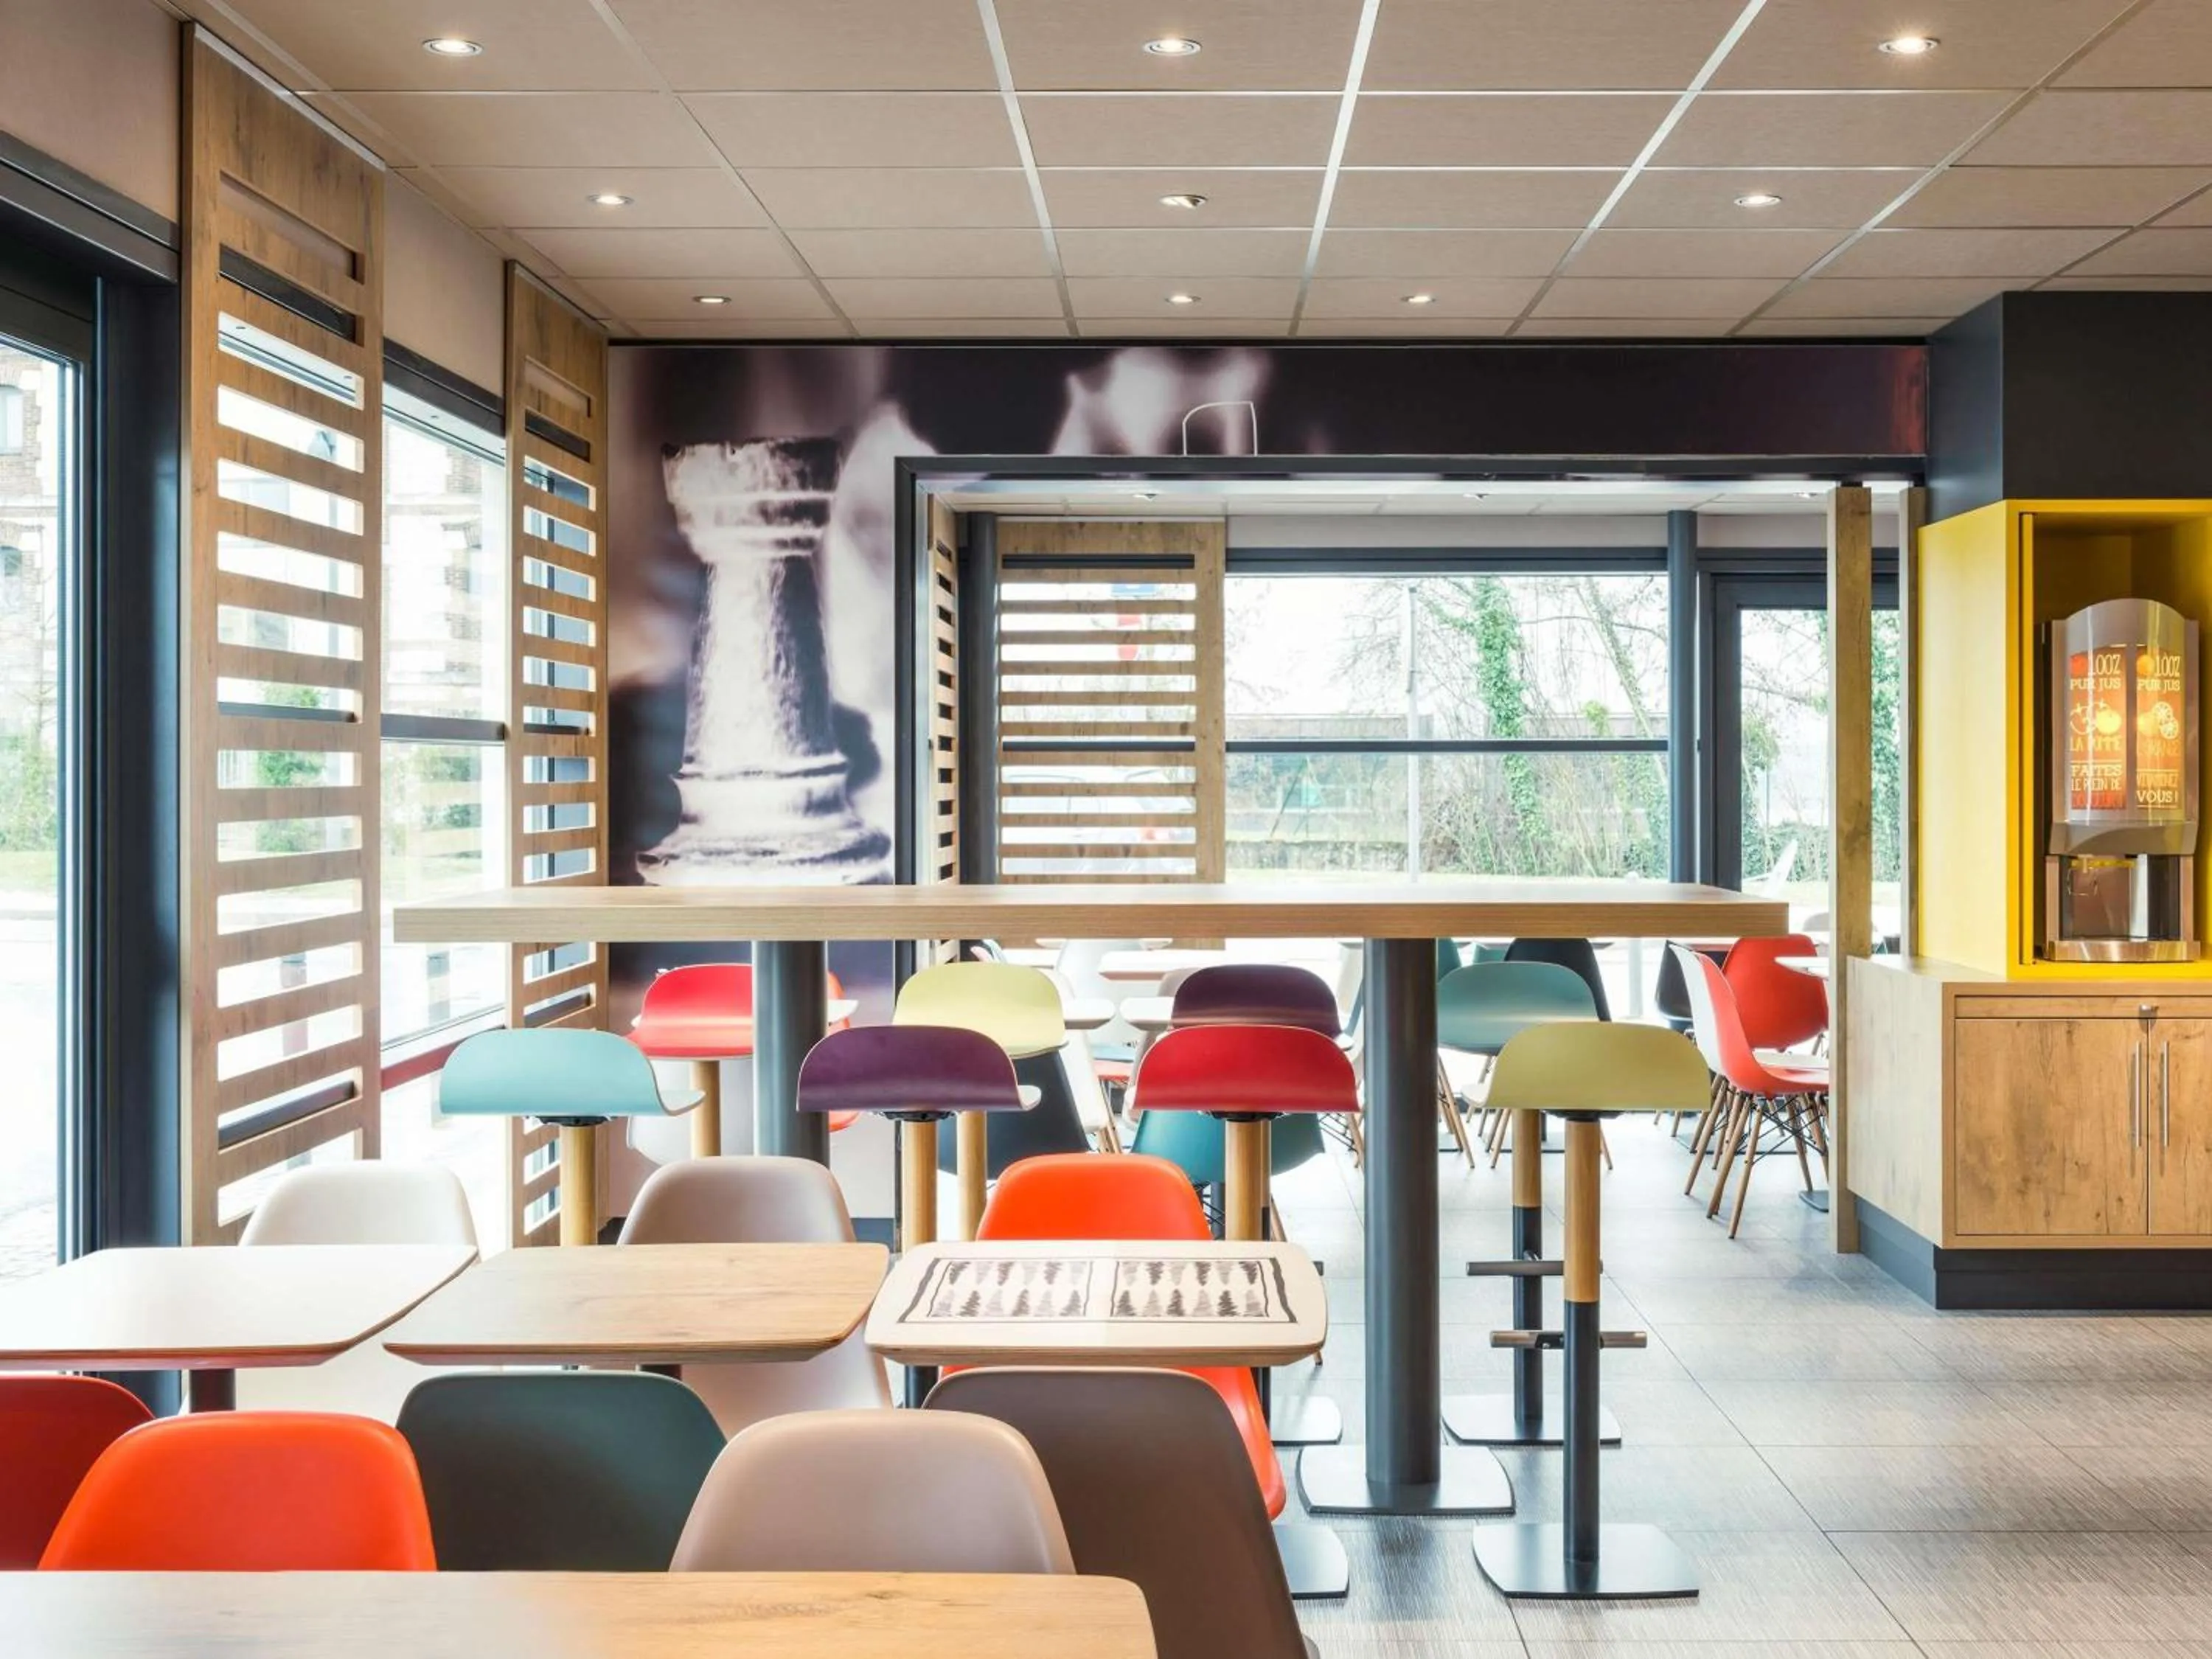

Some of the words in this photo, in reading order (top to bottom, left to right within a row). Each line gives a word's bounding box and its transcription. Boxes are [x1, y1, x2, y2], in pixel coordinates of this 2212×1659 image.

[2070, 678, 2096, 691] PUR
[2098, 678, 2121, 692] JUS
[2163, 679, 2181, 695] JUS
[2083, 778, 2109, 791] PEIN
